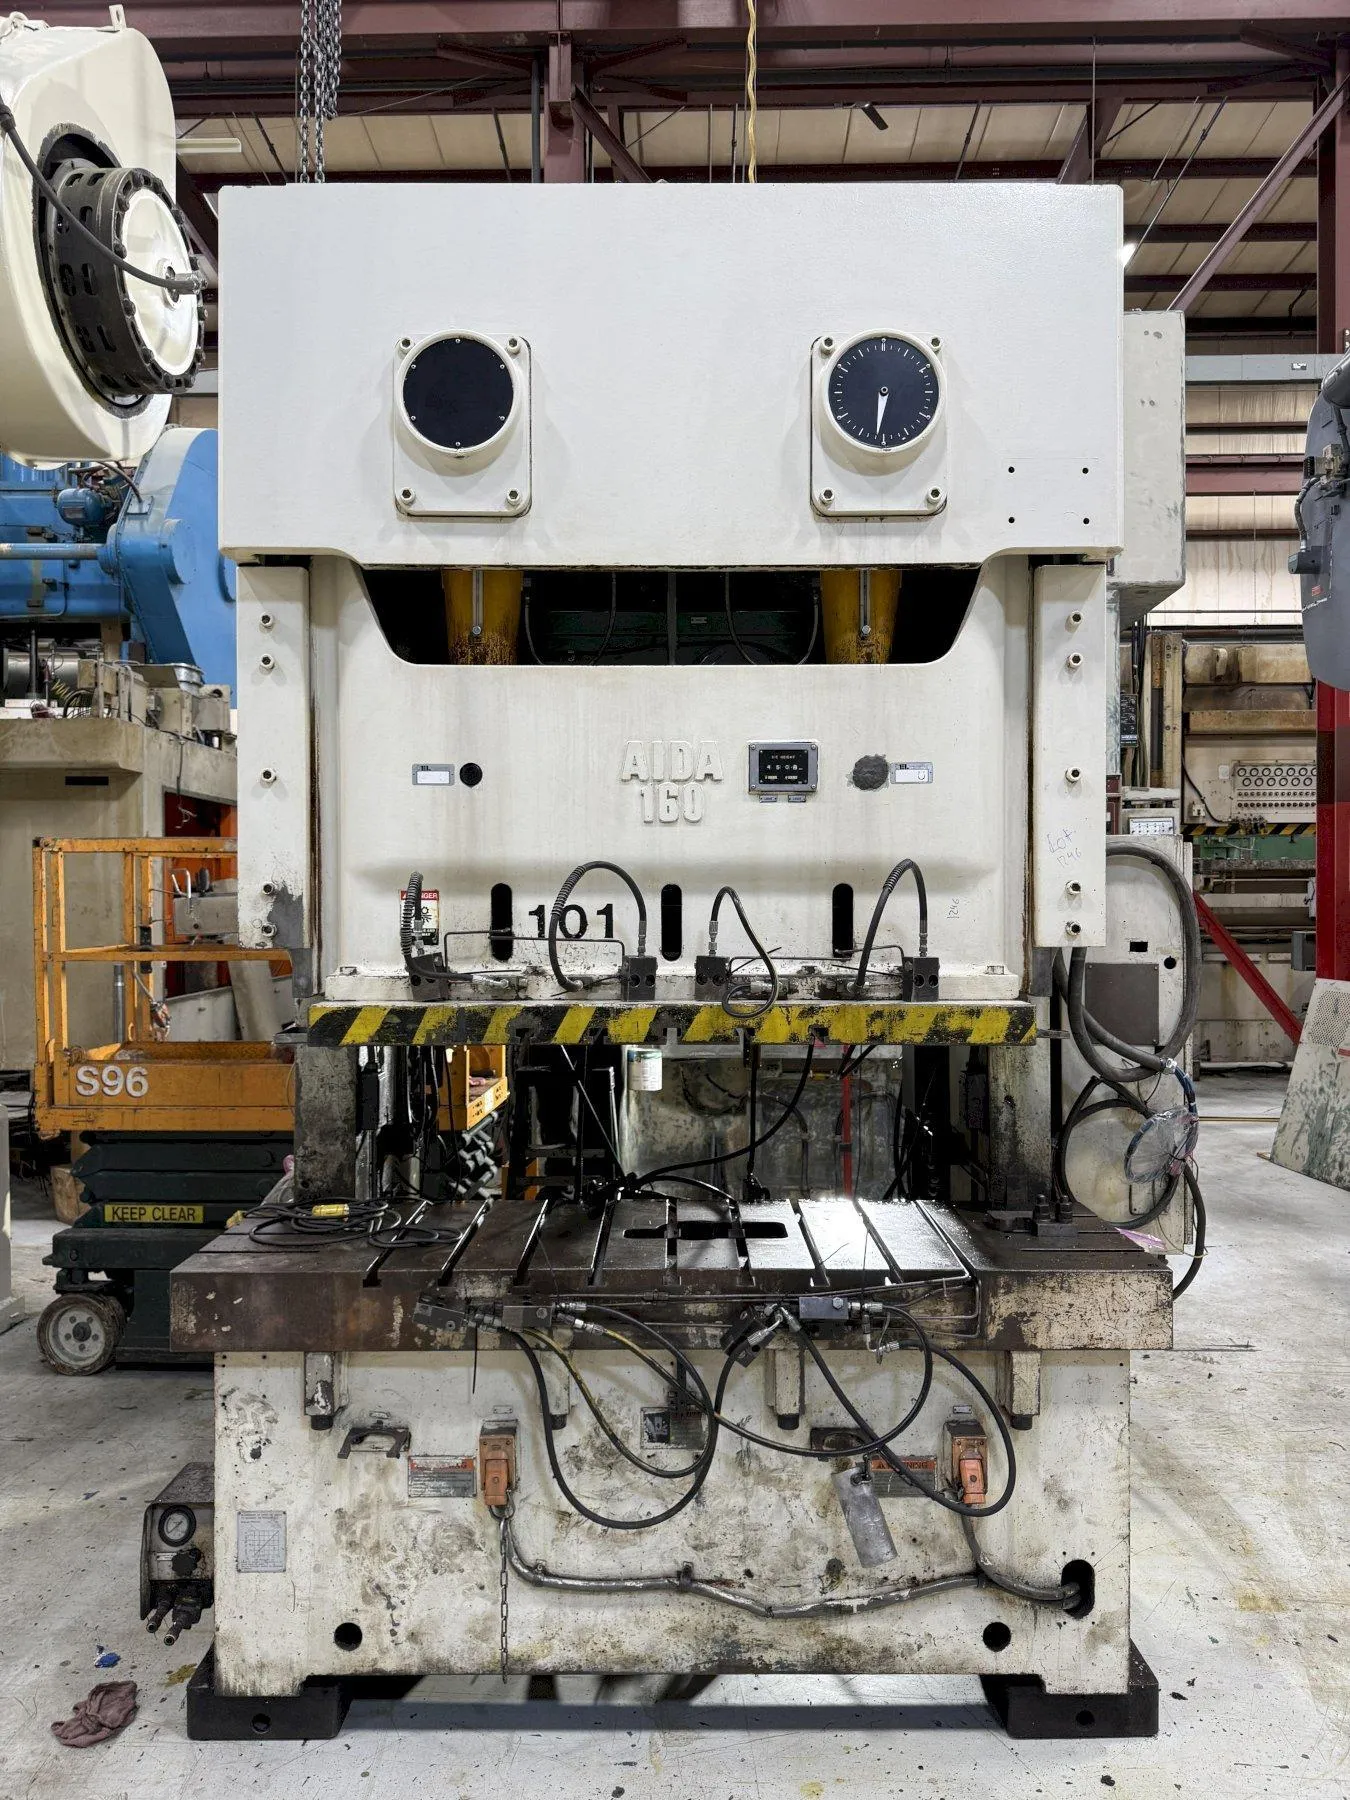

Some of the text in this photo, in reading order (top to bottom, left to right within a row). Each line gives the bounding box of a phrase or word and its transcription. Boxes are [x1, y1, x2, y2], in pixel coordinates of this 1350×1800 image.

[619, 740, 724, 783] AIDA
[640, 782, 703, 824] 160
[528, 903, 614, 940] 101
[76, 1065, 149, 1097] S96
[112, 1206, 196, 1221] KEEP CLEAR
